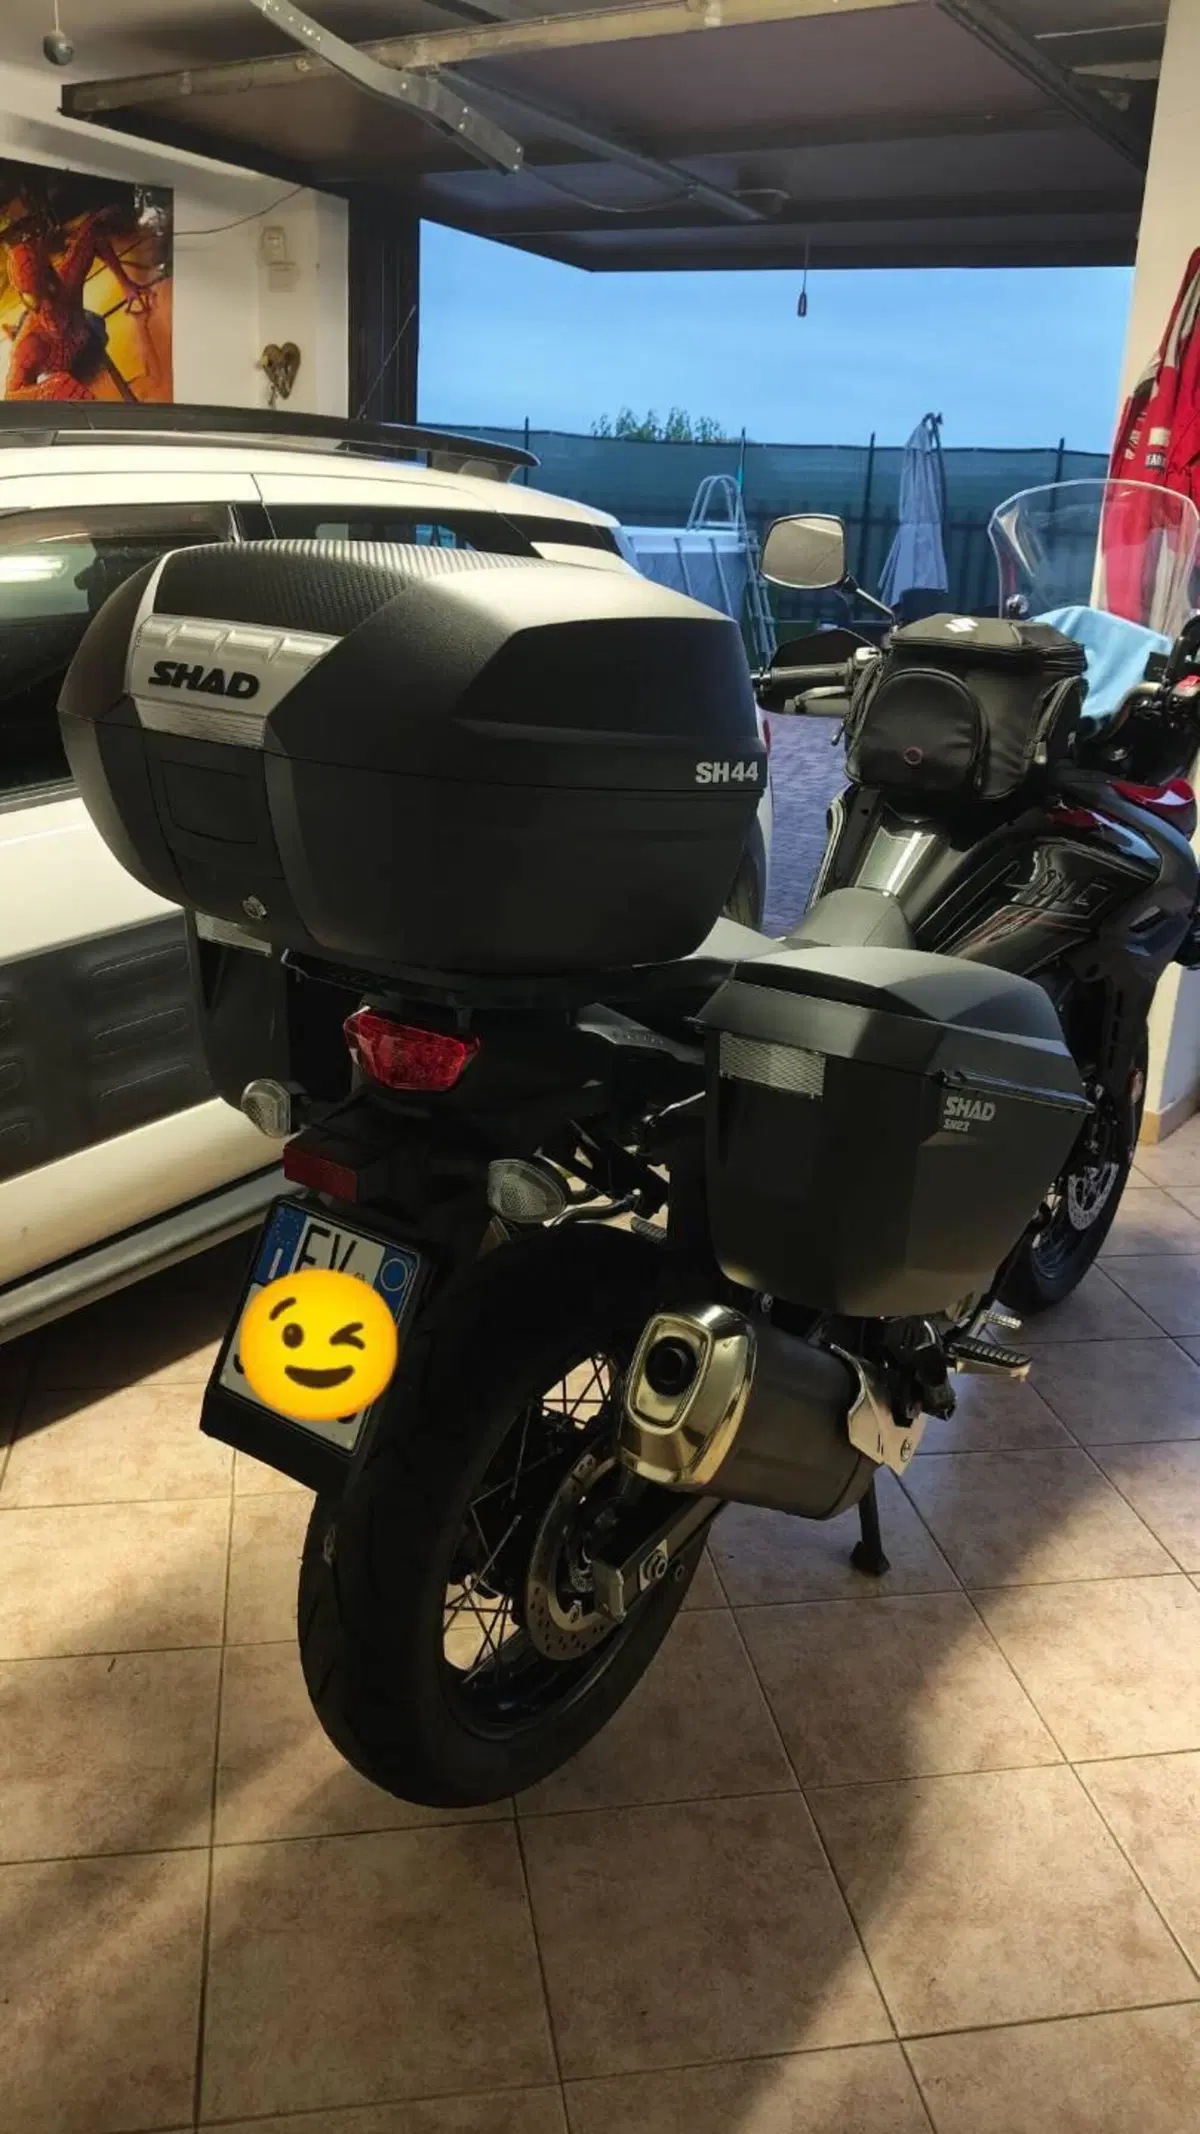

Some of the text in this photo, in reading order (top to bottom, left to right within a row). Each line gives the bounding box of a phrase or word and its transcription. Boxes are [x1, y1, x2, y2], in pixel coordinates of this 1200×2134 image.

[148, 661, 260, 699] SHAD
[695, 761, 759, 783] SH44
[943, 1096, 996, 1121] SHAD
